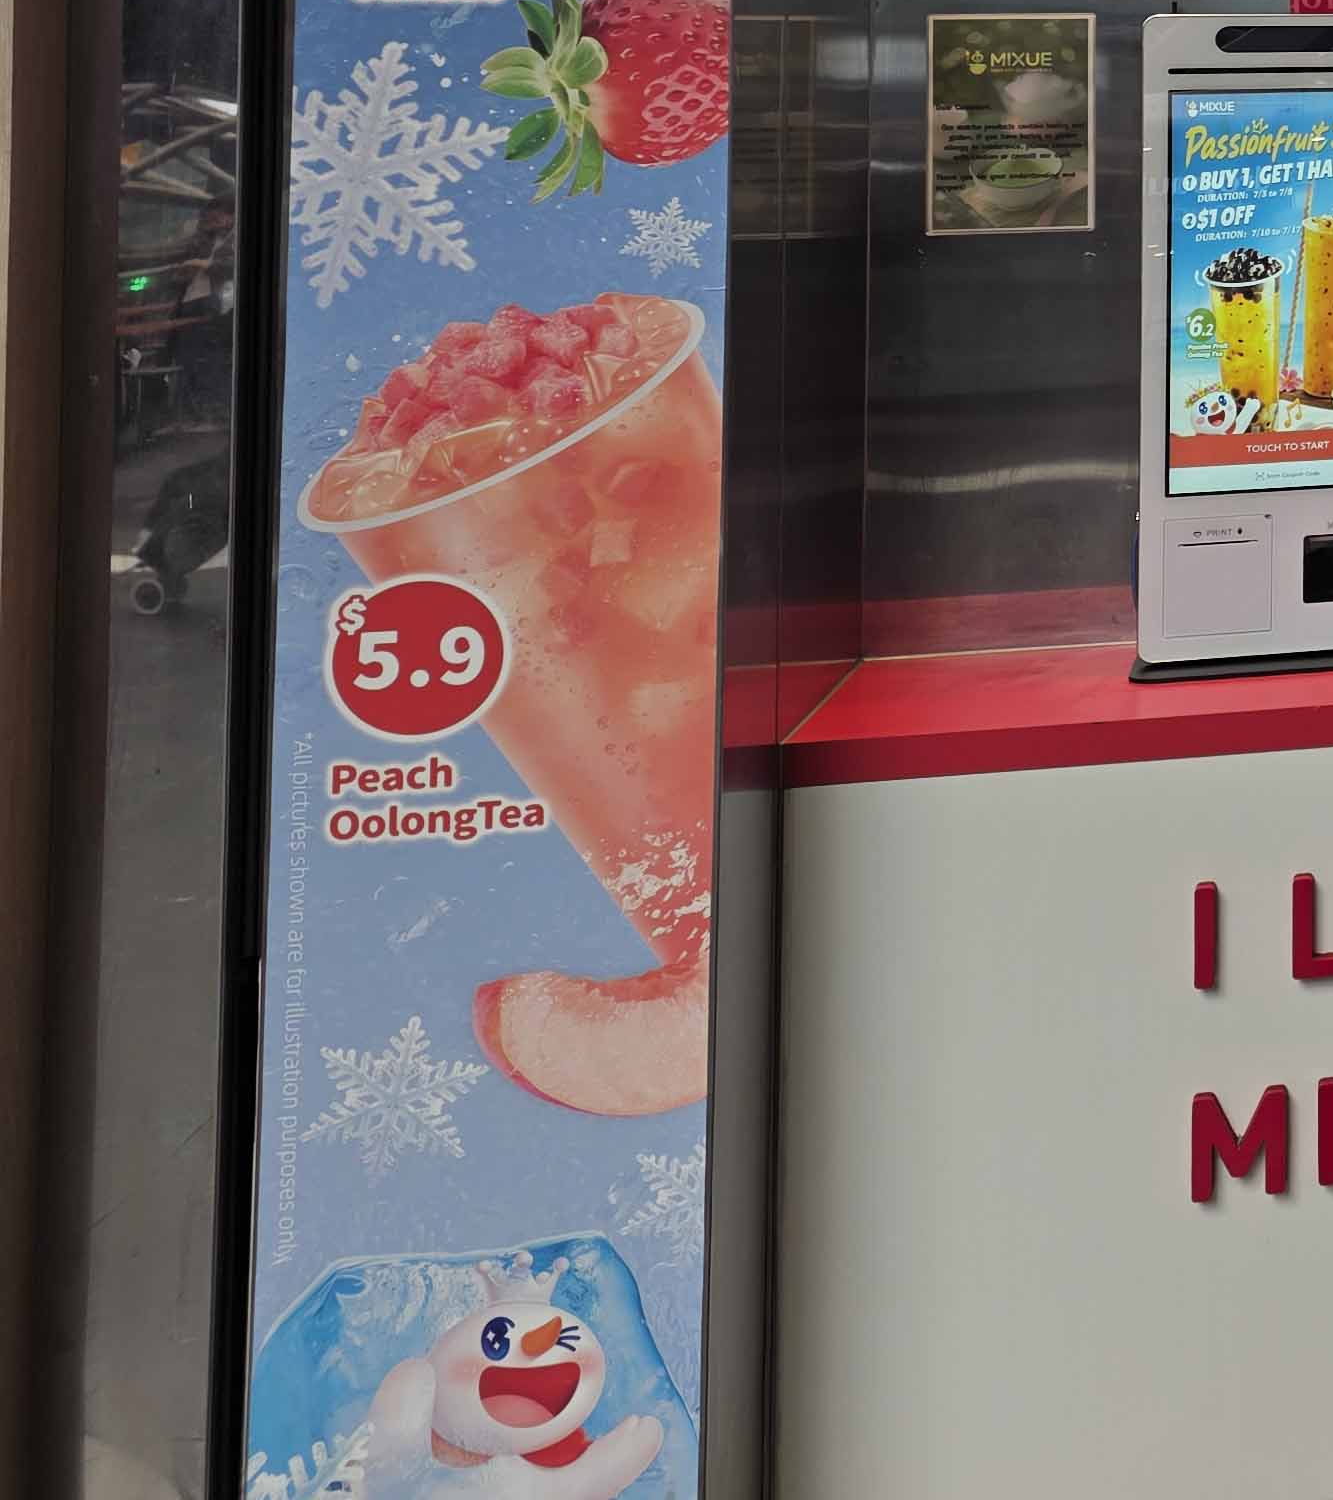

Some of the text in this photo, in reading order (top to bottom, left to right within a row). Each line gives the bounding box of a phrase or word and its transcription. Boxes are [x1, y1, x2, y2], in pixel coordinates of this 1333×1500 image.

[990, 51, 1053, 67] MIXUE
[1199, 168, 1240, 190] BUY
[1259, 162, 1295, 184] GET
[1197, 204, 1256, 231] $1 OFF
[1246, 440, 1330, 453] TOUCH TO START
[329, 757, 455, 796] Peach
[287, 770, 313, 850] pictures
[328, 798, 546, 843] OolongTea
[288, 855, 310, 925] shown
[287, 929, 305, 963] are
[1193, 881, 1217, 989] I
[286, 965, 307, 998] for
[282, 1003, 305, 1109] illustration
[275, 1115, 297, 1212] purposes
